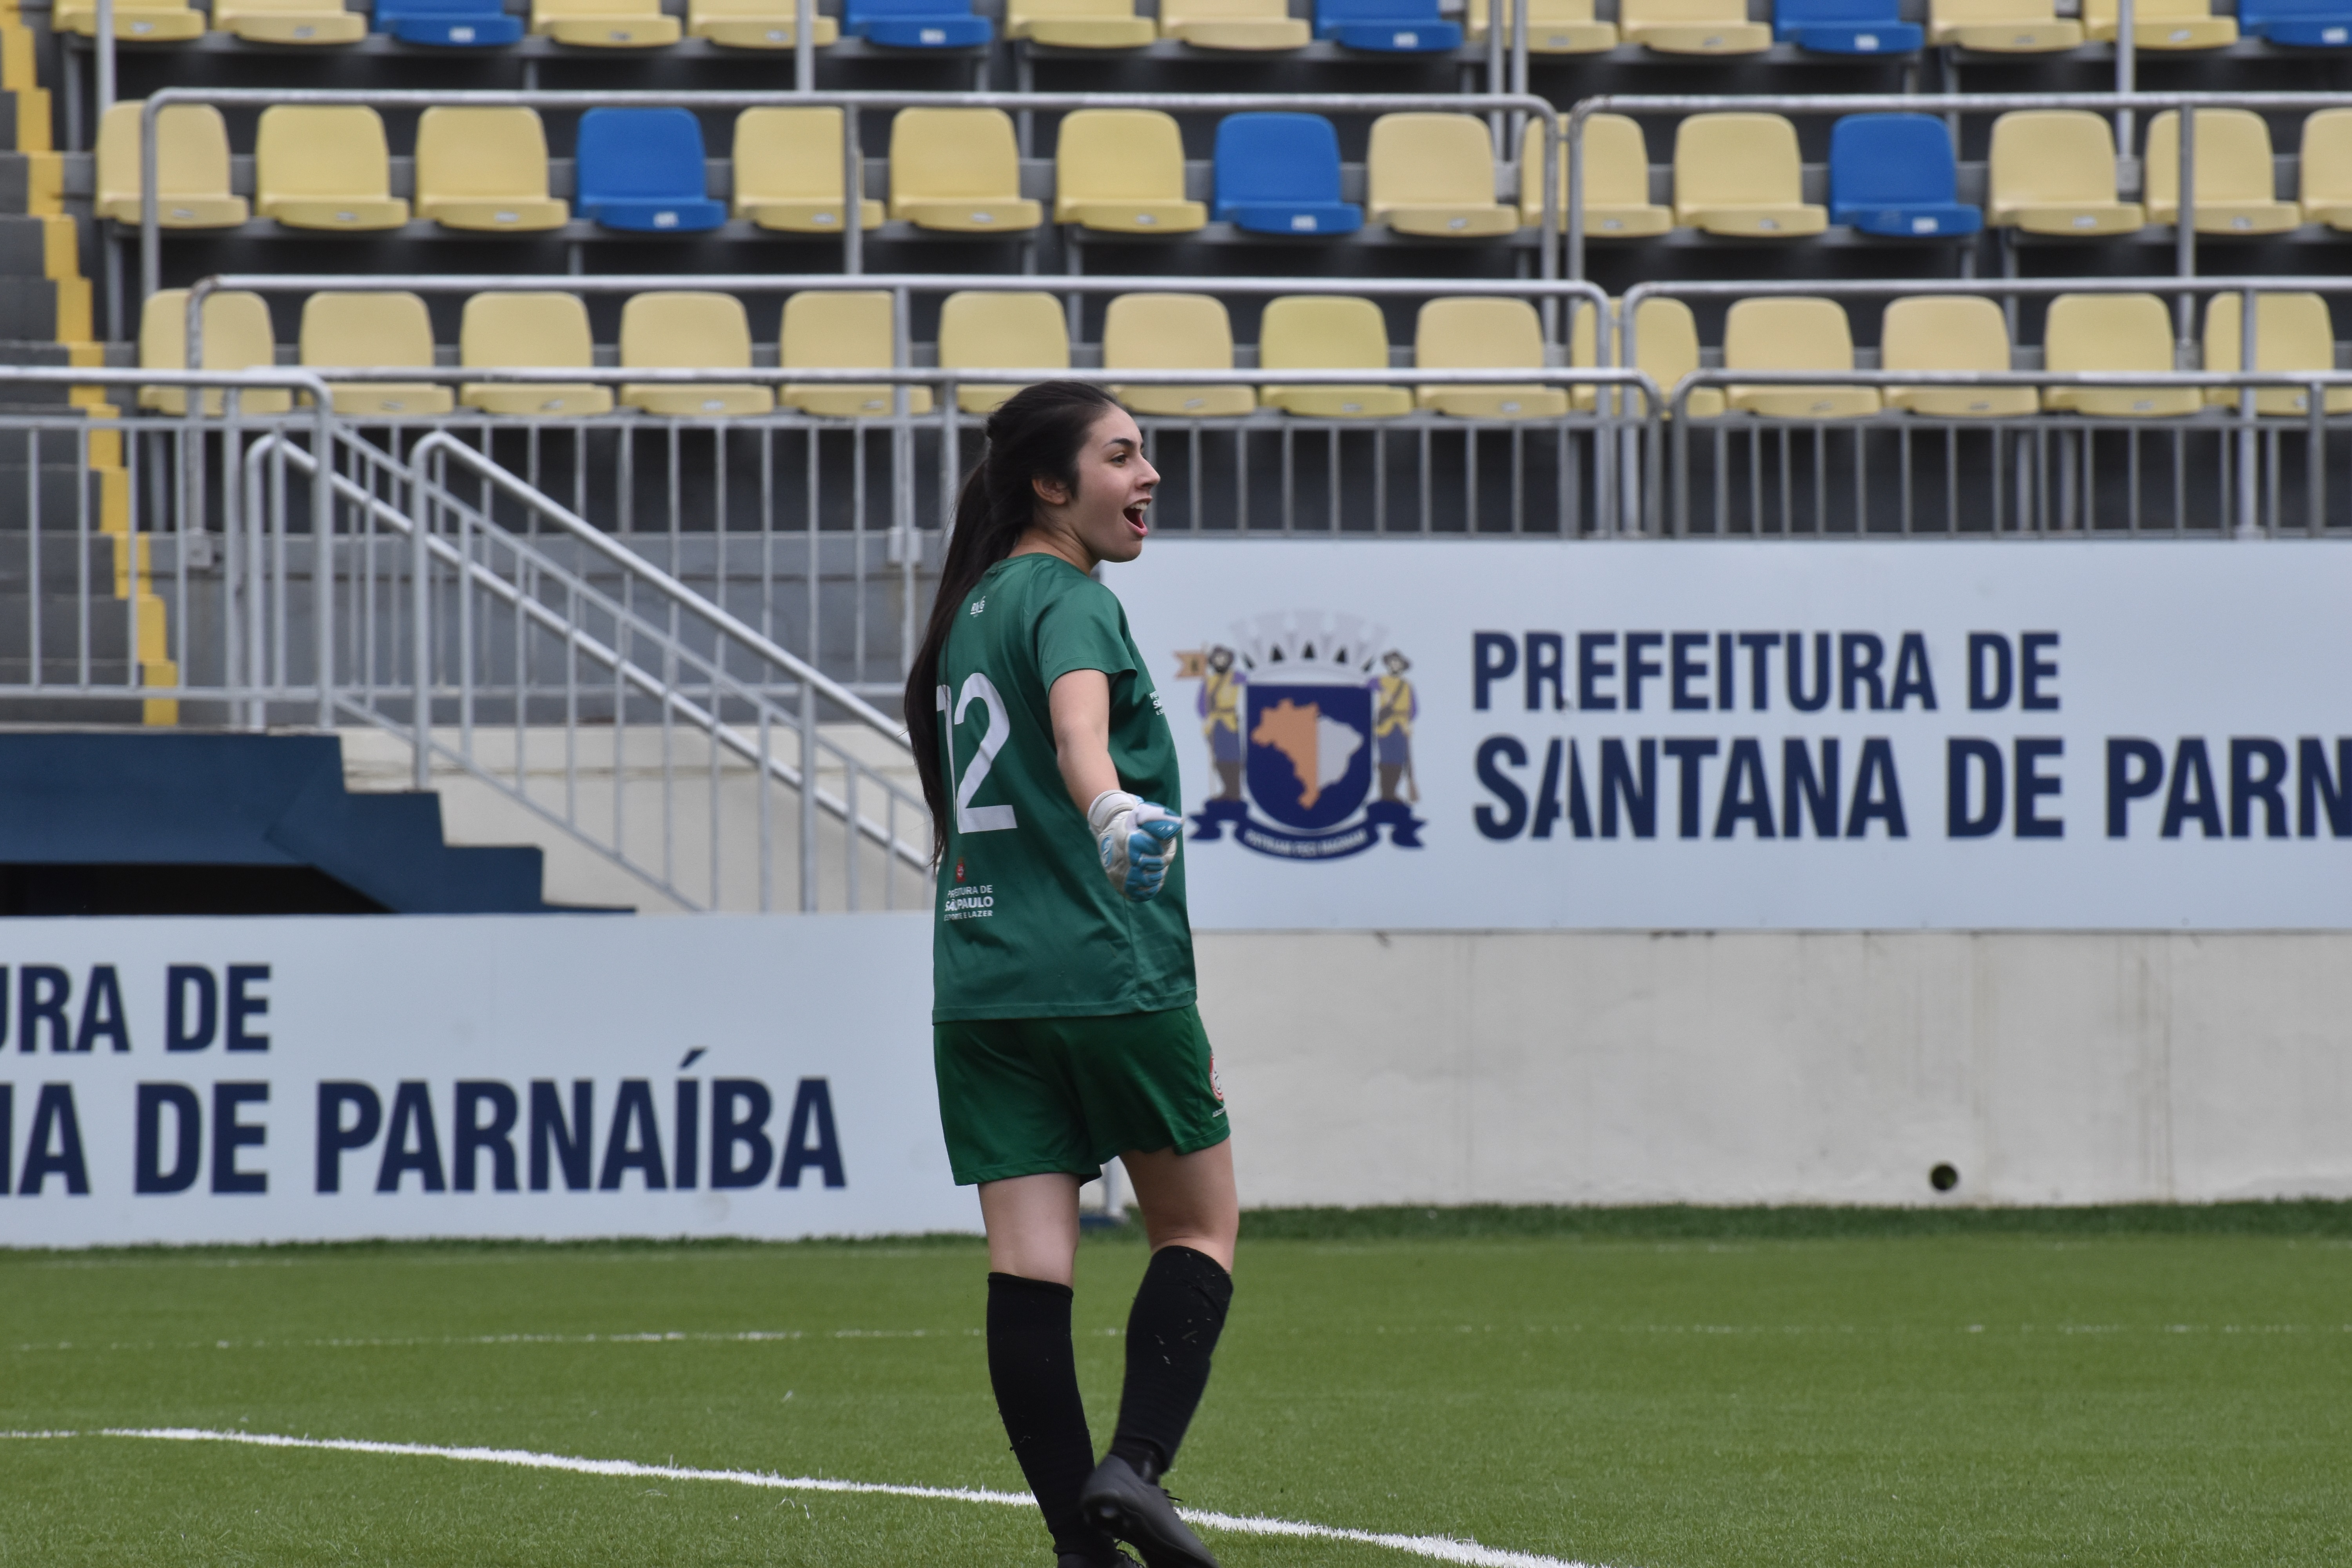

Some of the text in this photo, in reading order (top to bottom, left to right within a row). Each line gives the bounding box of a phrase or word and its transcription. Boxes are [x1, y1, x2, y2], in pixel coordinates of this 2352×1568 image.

[1473, 631, 2060, 713] PREFEITURA DE
[1473, 734, 1909, 842] SANTANA
[1946, 737, 2065, 840] DE
[957, 896, 993, 909] PAULO
[980, 885, 993, 893] DE
[0, 963, 271, 1054] RA DE
[0, 1048, 847, 1197] A DE PARNAÍBA
